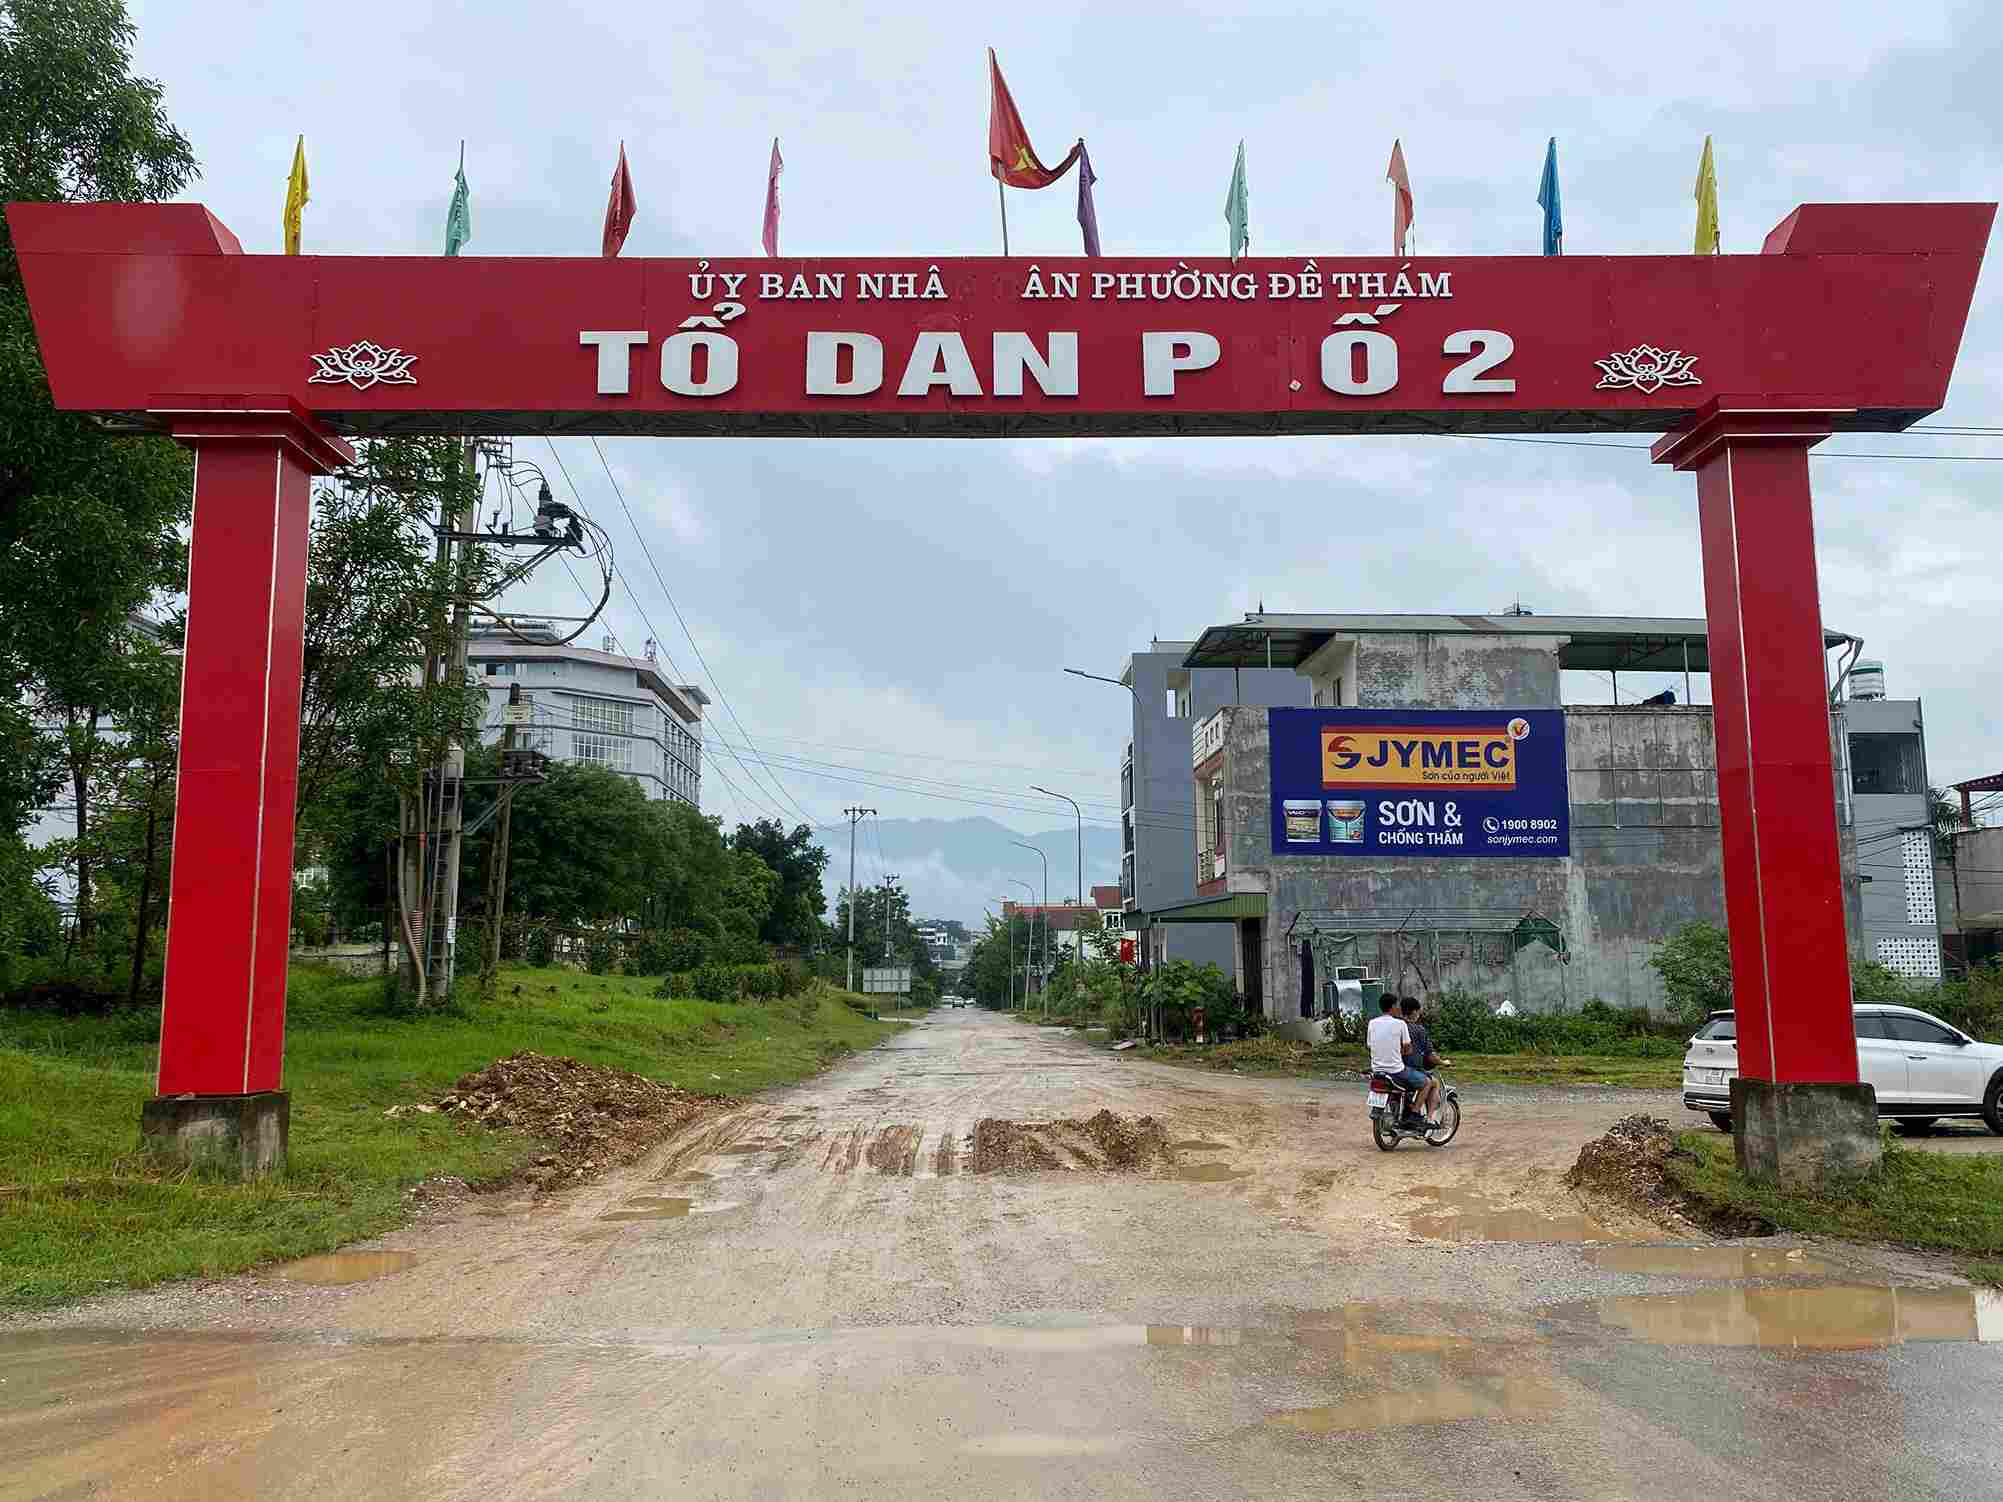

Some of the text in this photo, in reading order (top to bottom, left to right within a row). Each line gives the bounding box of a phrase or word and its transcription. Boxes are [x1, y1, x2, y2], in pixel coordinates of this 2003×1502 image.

[688, 260, 747, 299] ỦY
[759, 273, 845, 299] BAN
[1091, 261, 1259, 298] PHƯỜNG
[1269, 259, 1325, 298] ĐỀ
[1333, 263, 1453, 298] THÁM
[579, 302, 747, 396] TỔ
[1442, 329, 1517, 394] 2
[1378, 799, 1462, 826] SƠN &
[1501, 819, 1558, 830] 1900 8902
[1378, 827, 1464, 845] CHỐNG THẤM
